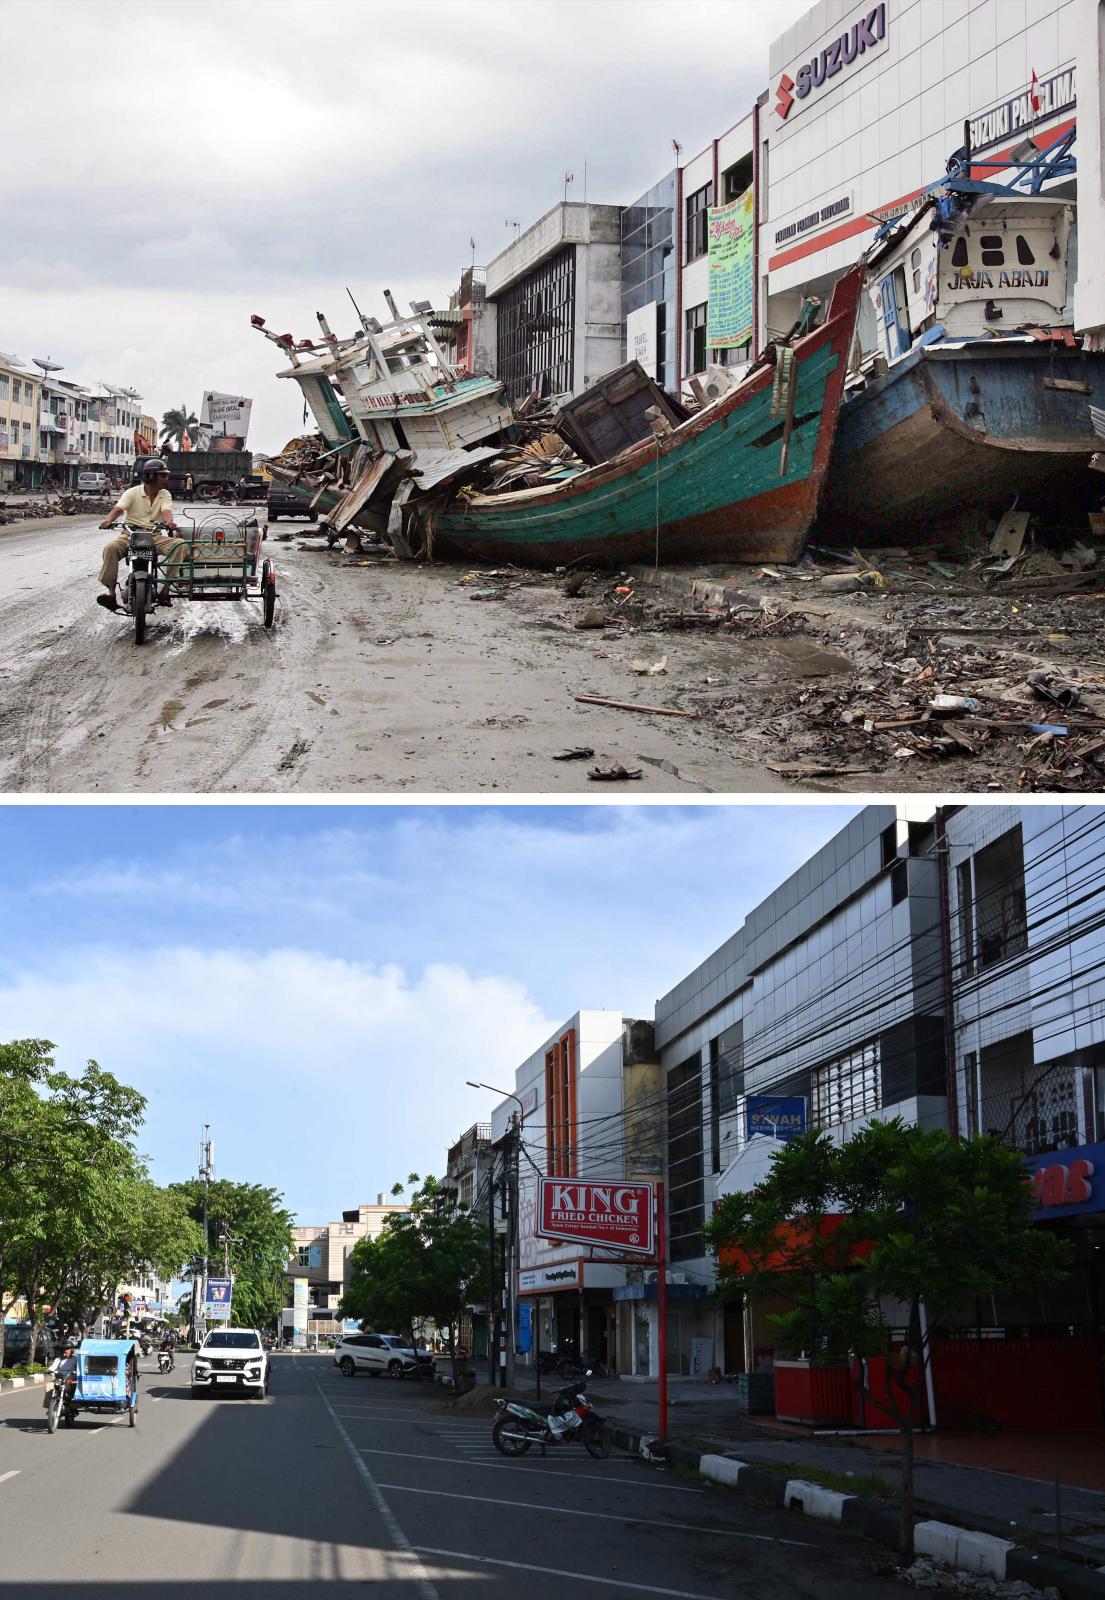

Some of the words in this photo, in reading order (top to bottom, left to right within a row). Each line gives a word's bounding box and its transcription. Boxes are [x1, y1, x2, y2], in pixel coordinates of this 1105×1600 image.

[796, 3, 885, 99] SUZUKI
[970, 104, 1009, 150] SUZUKI
[998, 270, 1049, 288] ABADI
[551, 1185, 639, 1213] KING
[1026, 1158, 1094, 1208] as
[551, 1212, 584, 1220] FRIED
[588, 1213, 638, 1224] CHICKEN
